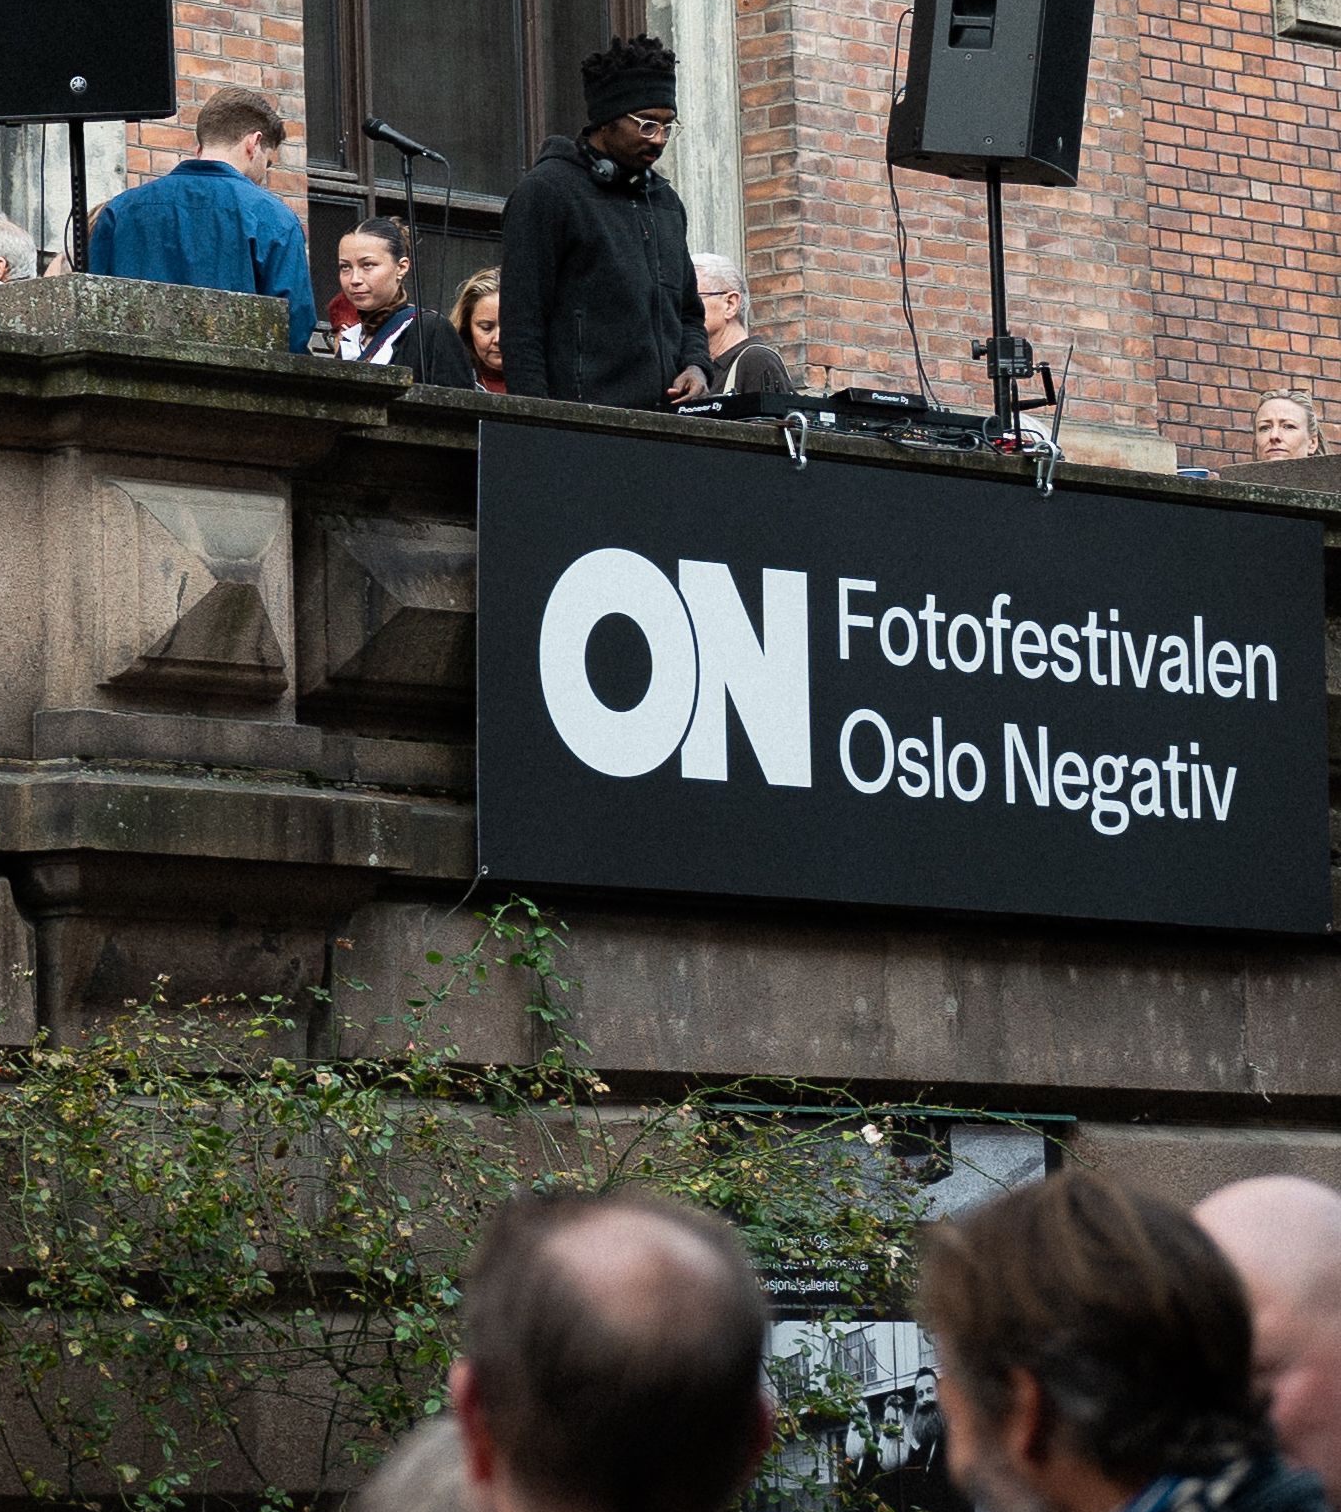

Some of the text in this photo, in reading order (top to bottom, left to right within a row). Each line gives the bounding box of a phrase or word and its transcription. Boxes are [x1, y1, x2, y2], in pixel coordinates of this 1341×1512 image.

[539, 547, 812, 788] ON
[838, 577, 1278, 702] Fotofestivalen
[839, 708, 1238, 836] Oslo Negativ
